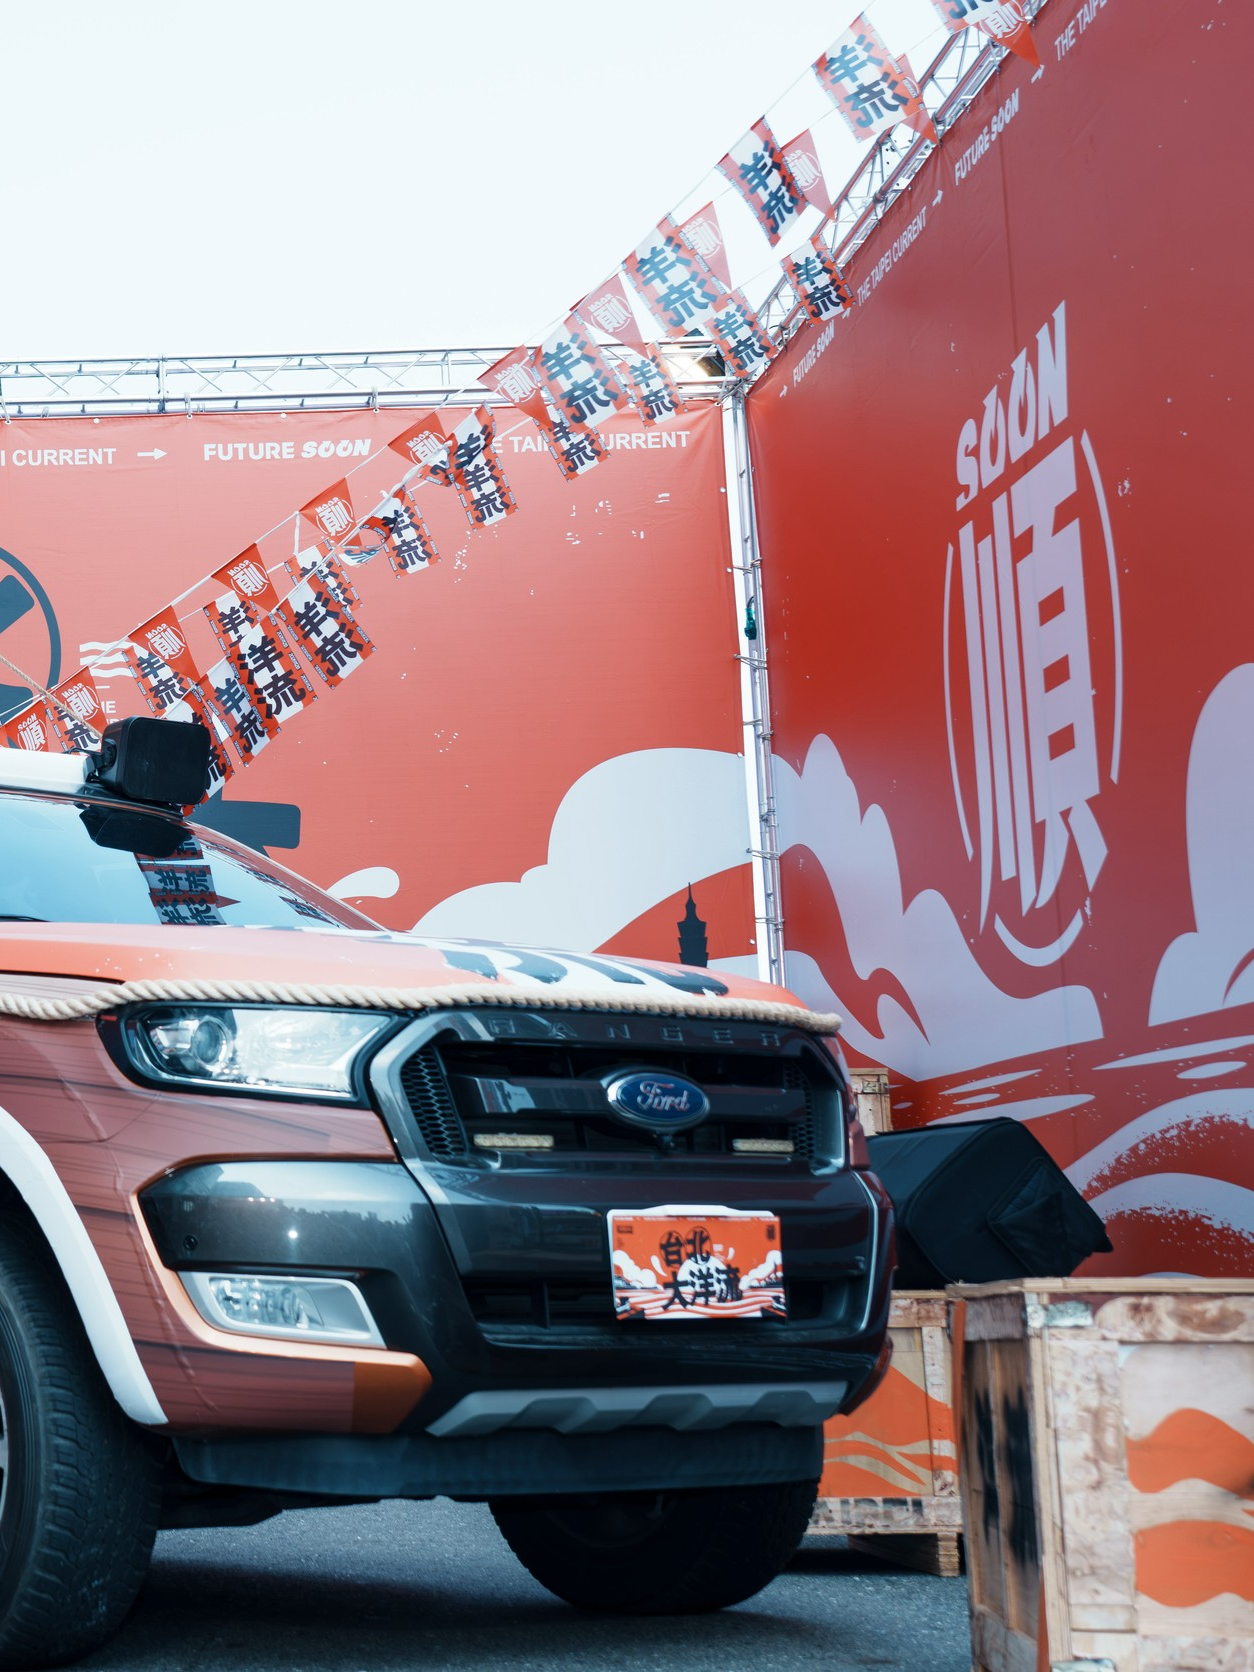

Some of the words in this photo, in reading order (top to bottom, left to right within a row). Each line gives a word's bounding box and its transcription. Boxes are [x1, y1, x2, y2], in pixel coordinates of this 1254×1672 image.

[1054, 20, 1076, 61] THE
[954, 125, 989, 186] FUTURE
[991, 88, 1019, 141] SOON
[857, 274, 871, 306] THE
[893, 206, 927, 263] CURRENT
[956, 300, 1068, 512] SOON
[12, 447, 116, 467] CURRENT
[204, 442, 295, 461] FUTURE
[301, 438, 371, 460] SOON
[509, 436, 549, 453] TAI
[601, 431, 690, 450] URRENT
[237, 635, 306, 719] 洋流
[959, 436, 1108, 936] 順
[487, 1015, 782, 1048] RANGER
[636, 1080, 690, 1112] Ford
[660, 1230, 711, 1267] 台北
[663, 1264, 743, 1311] 大洋流
